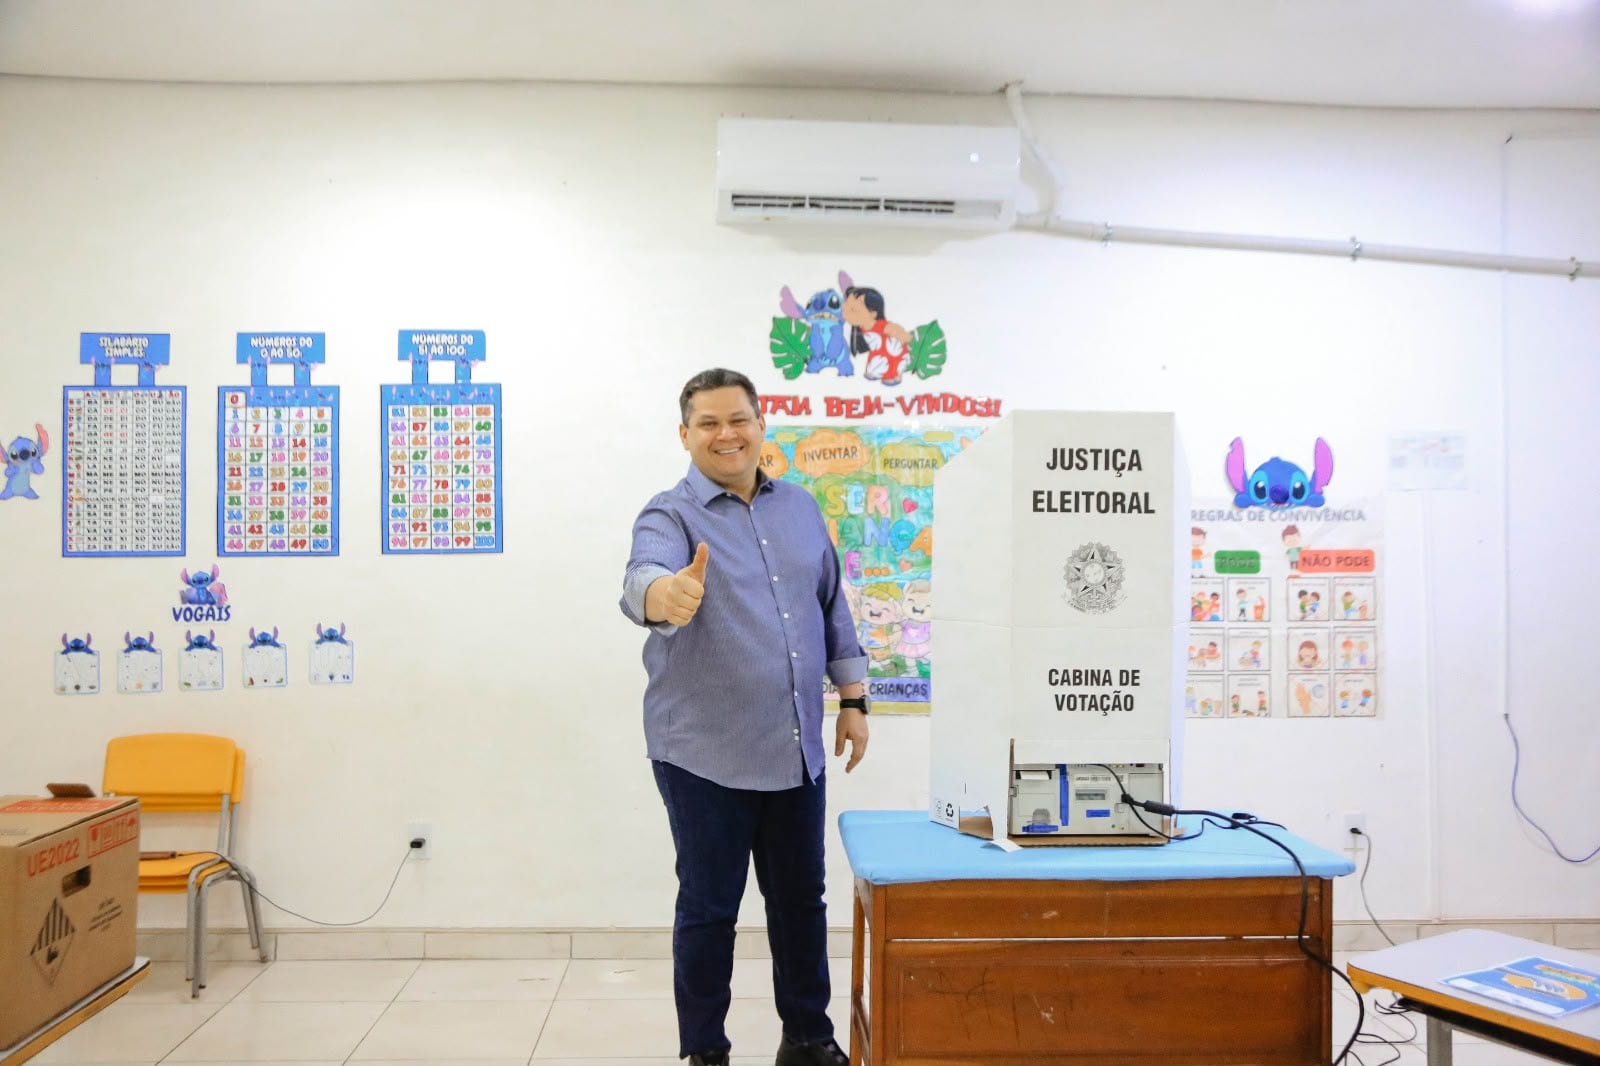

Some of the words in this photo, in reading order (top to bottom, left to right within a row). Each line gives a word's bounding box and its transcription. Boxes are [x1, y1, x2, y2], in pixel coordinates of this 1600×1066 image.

[300, 337, 313, 348] DO
[461, 334, 474, 345] DO
[271, 348, 283, 358] AO
[431, 345, 443, 355] AO
[254, 424, 260, 433] 7
[314, 424, 328, 434] 10
[412, 422, 426, 432] 57
[476, 422, 491, 432] 60
[293, 438, 306, 448] 14
[455, 437, 470, 447] 64
[249, 453, 263, 463] 17
[413, 451, 427, 461] 67
[803, 446, 858, 462] INVENTAR
[883, 458, 938, 470] PERGUNTAR
[1046, 448, 1143, 477] JUSTIÇA
[229, 467, 241, 477] 21
[292, 467, 305, 477] 24
[393, 465, 405, 475] 71
[413, 465, 427, 475] 72
[456, 465, 469, 475] 74
[272, 482, 285, 492] 28
[413, 479, 426, 490] 77
[456, 479, 470, 489] 79
[825, 482, 888, 516] SER
[1032, 490, 1156, 514] ELEITORAL
[1191, 509, 1243, 522] REGRAS
[1248, 510, 1265, 522] DE
[1269, 508, 1367, 522] CONVIVÊNCIA
[229, 526, 241, 536] 41
[249, 525, 262, 535] 42
[392, 523, 406, 533] 91
[413, 523, 426, 533] 92
[291, 540, 306, 549] 49
[456, 537, 470, 546] 99
[1302, 554, 1331, 568] NÃO
[1336, 556, 1371, 568] PODE
[172, 605, 231, 622] VOGAIS
[1048, 669, 1113, 686] CABINA
[1119, 669, 1140, 687] DE
[869, 683, 928, 698] CRIANÇAS
[1054, 690, 1135, 716] VOTAÇÃO
[27, 837, 80, 878] UE2022
